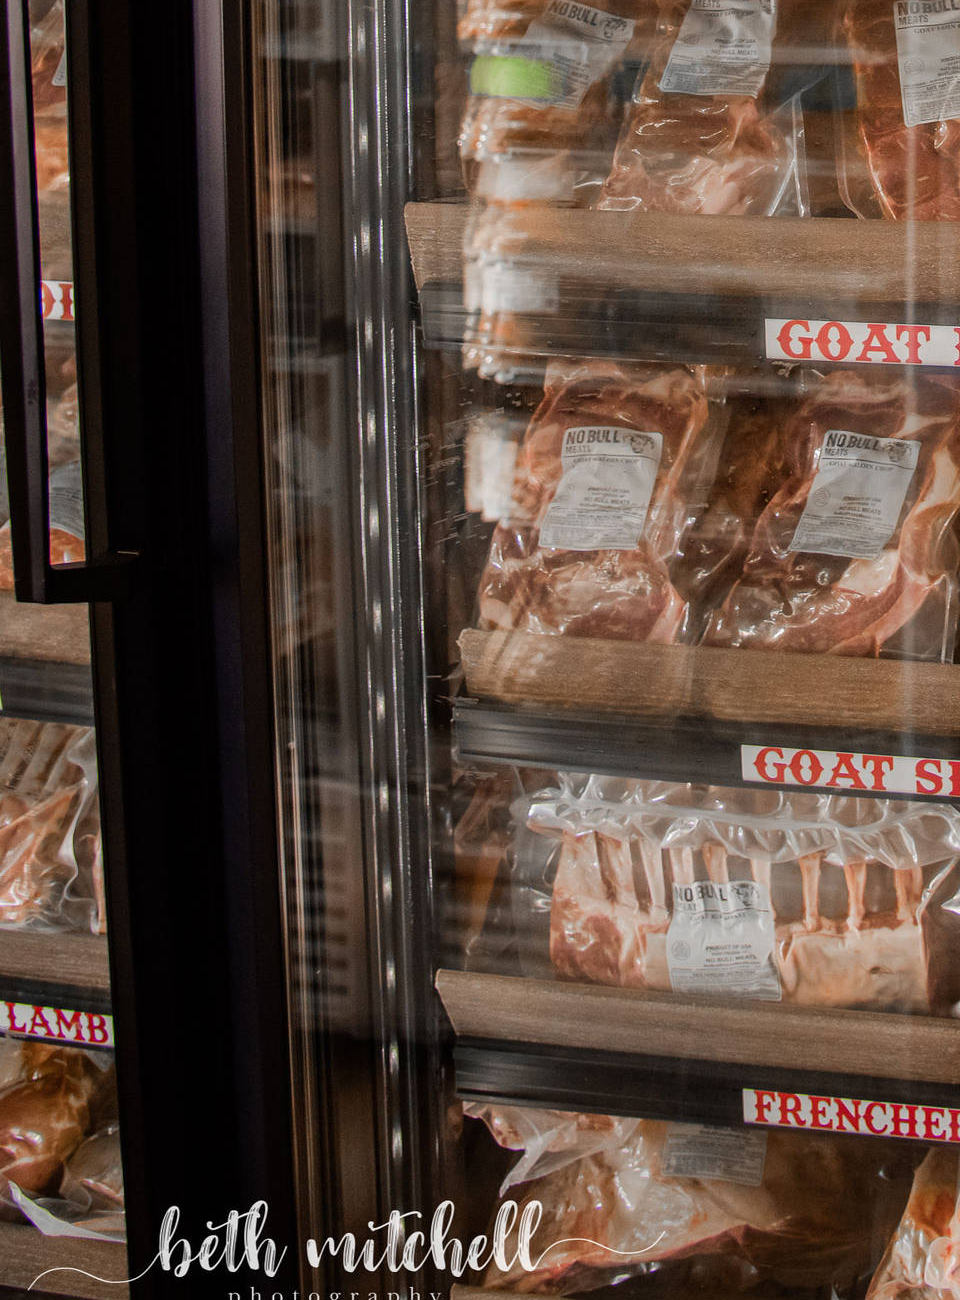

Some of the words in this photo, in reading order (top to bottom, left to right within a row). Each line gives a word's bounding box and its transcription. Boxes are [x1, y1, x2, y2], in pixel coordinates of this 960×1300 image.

[548, 0, 569, 16] NO
[568, 5, 598, 27] BULL
[897, 1, 920, 15] NO
[777, 319, 930, 363] GOAT
[566, 430, 585, 444] NO
[587, 430, 619, 444] BULL
[826, 433, 846, 447] NO
[847, 435, 881, 451] BULL
[753, 746, 894, 791] GOAT
[5, 1002, 109, 1044] LAMB
